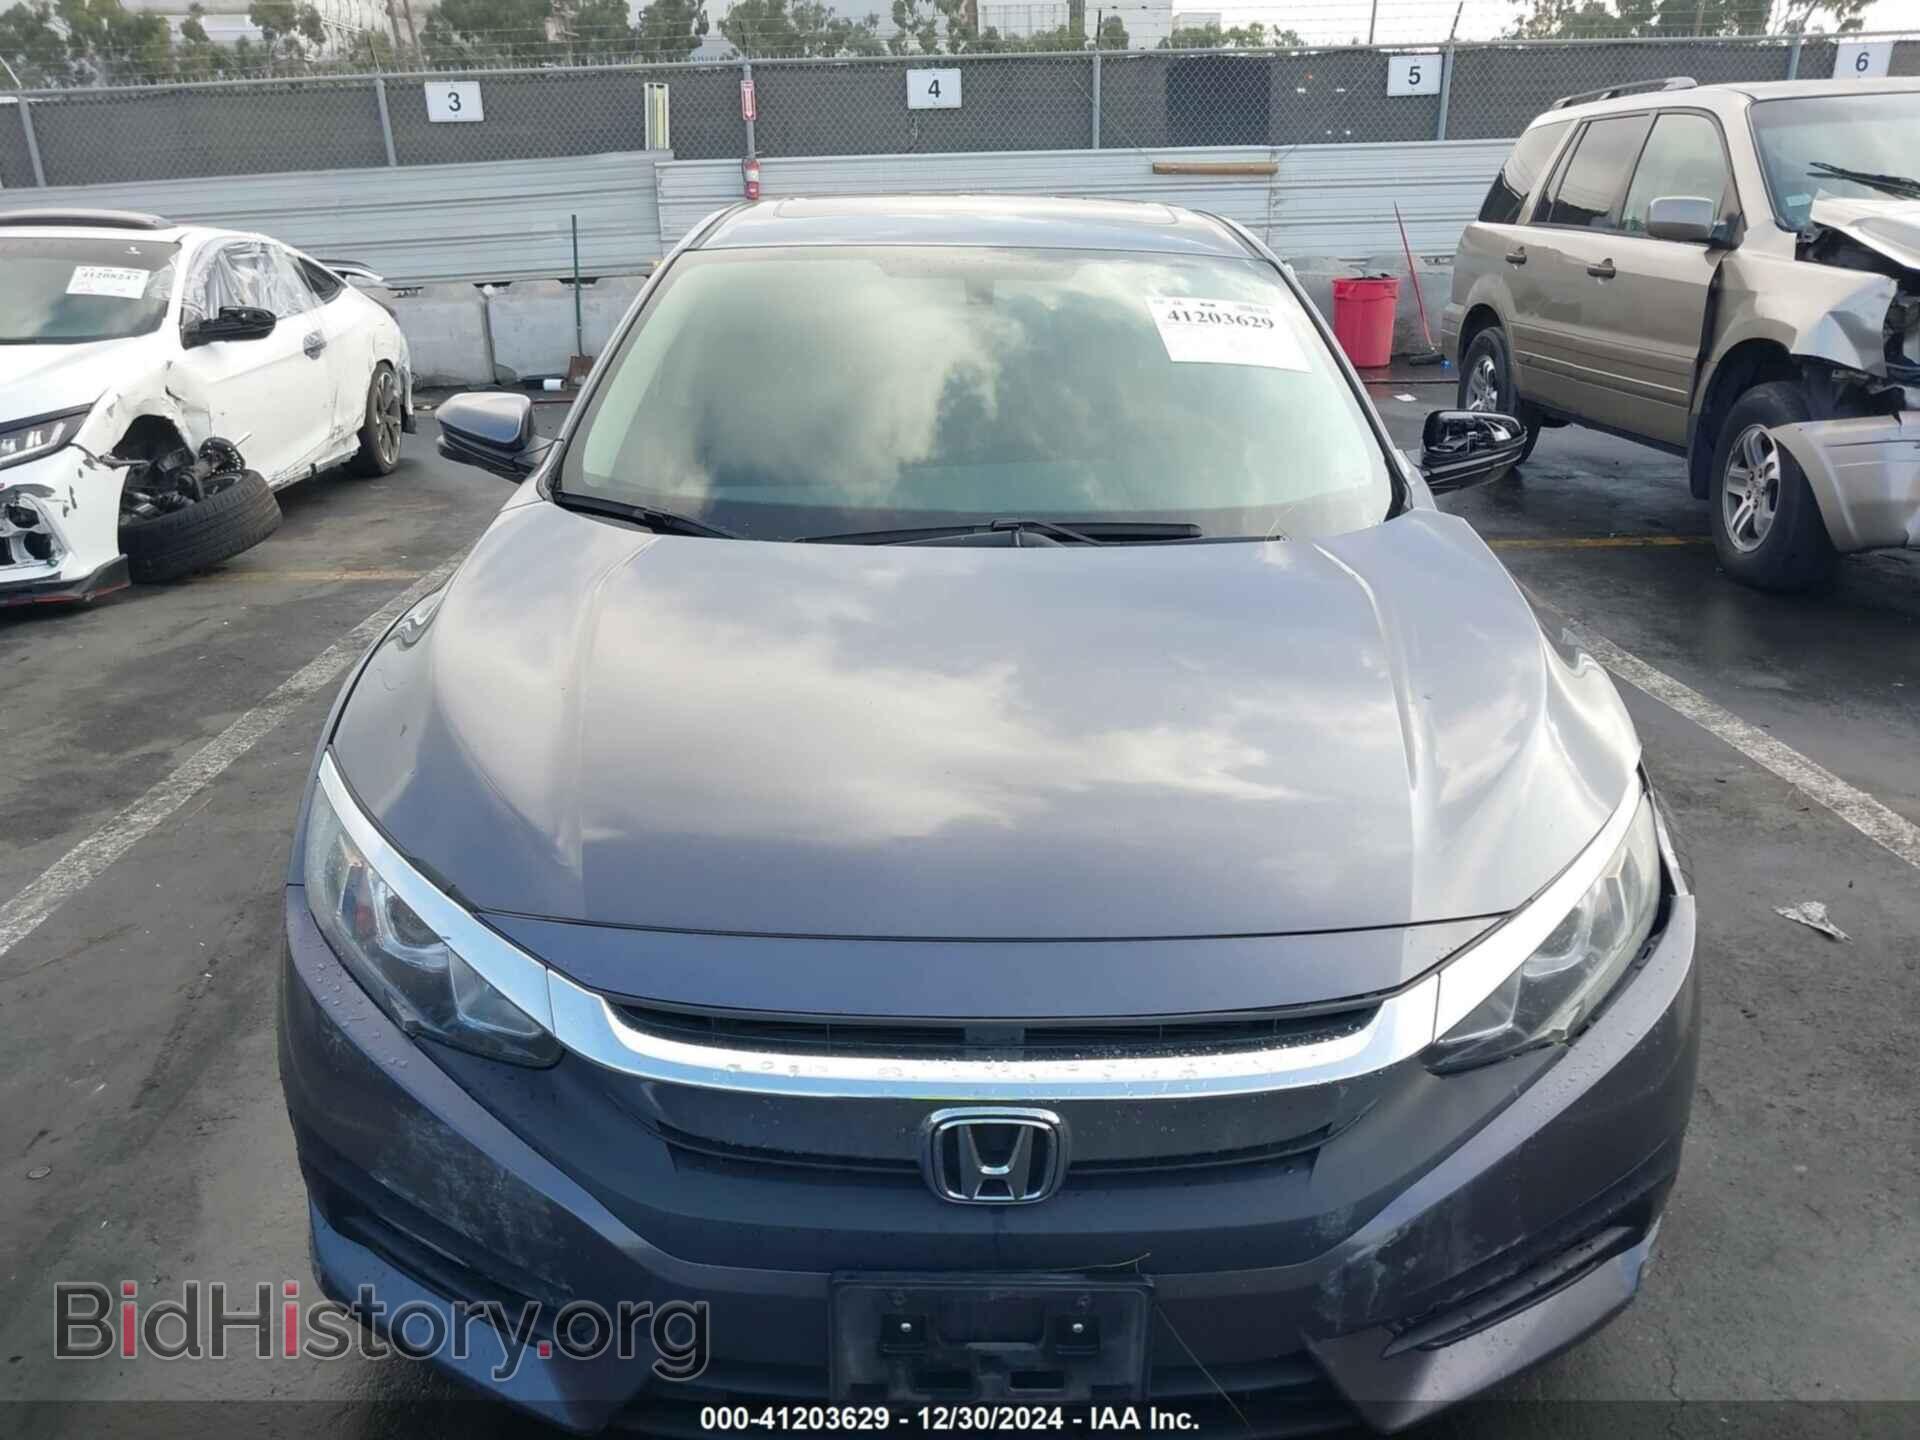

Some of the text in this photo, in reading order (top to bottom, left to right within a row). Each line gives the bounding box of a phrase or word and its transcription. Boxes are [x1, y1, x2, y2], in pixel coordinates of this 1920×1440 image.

[1855, 51, 1869, 72] 6
[1407, 65, 1421, 85] 5
[927, 79, 942, 98] 4
[447, 92, 461, 112] 3
[1167, 309, 1275, 329] 41203629
